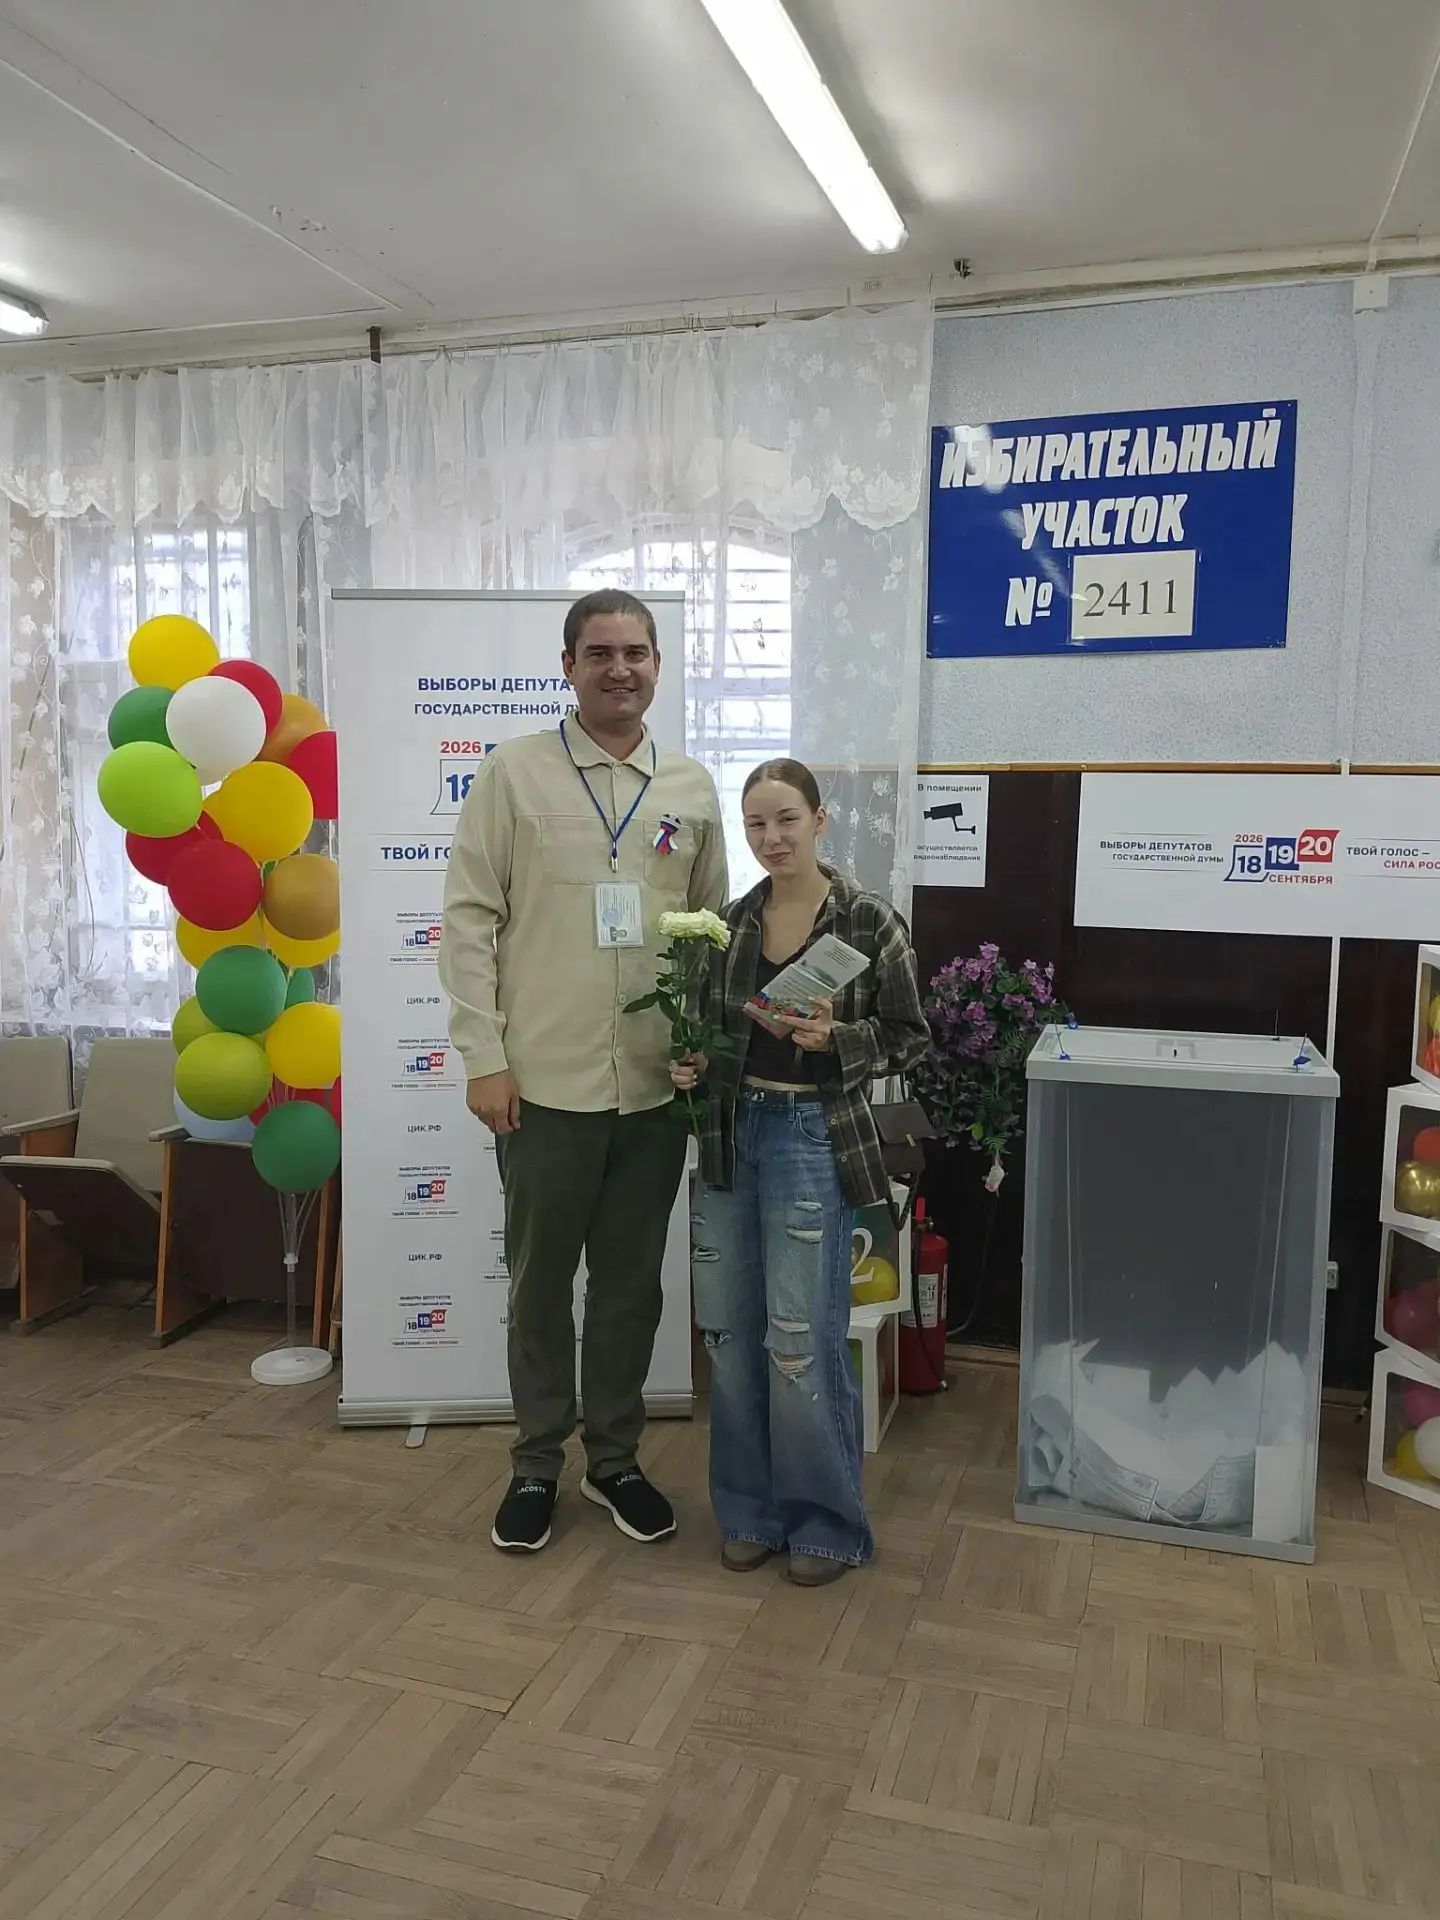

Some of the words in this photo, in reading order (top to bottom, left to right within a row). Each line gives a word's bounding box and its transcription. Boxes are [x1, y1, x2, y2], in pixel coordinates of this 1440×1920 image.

[939, 408, 1281, 488] ИЗБИРАТЕЛЬНЫЙ
[1021, 494, 1189, 549] УЧАСТОК
[1082, 578, 1177, 618] 2411
[418, 678, 496, 691] ВЫБОРЫ
[501, 678, 572, 693] ДЕПУТА
[414, 701, 561, 716] ГОСУДАРСТВЕННОЙ
[440, 741, 482, 754] 2026
[917, 783, 924, 792] В
[926, 784, 982, 793] помещении
[1235, 834, 1263, 842] 2026
[380, 843, 429, 860] ТВОЙ
[1100, 841, 1146, 850] ВЫБОРЫ
[1148, 842, 1212, 851] ДЕПУТАТОВ
[1346, 846, 1377, 856] ТВОЙ
[1380, 848, 1419, 857] ГОЛОС
[1112, 853, 1196, 862] ГОСУДАРСТВЕННОЙ
[1237, 855, 1262, 874] 18
[1268, 845, 1294, 864] 19
[1299, 836, 1332, 856] 20
[1384, 860, 1415, 869] СИЛА
[1269, 874, 1333, 884] СЕНТЯБРЯ
[405, 938, 415, 947] 18
[428, 929, 441, 938] 20
[406, 1064, 416, 1073] 18
[417, 1060, 428, 1069] 19
[430, 1056, 443, 1064] 20
[407, 1192, 417, 1201] 18
[418, 1187, 429, 1196] 19
[431, 1183, 444, 1192] 20
[408, 1322, 418, 1330] 18
[419, 1316, 430, 1326] 19
[431, 1312, 444, 1321] 20
